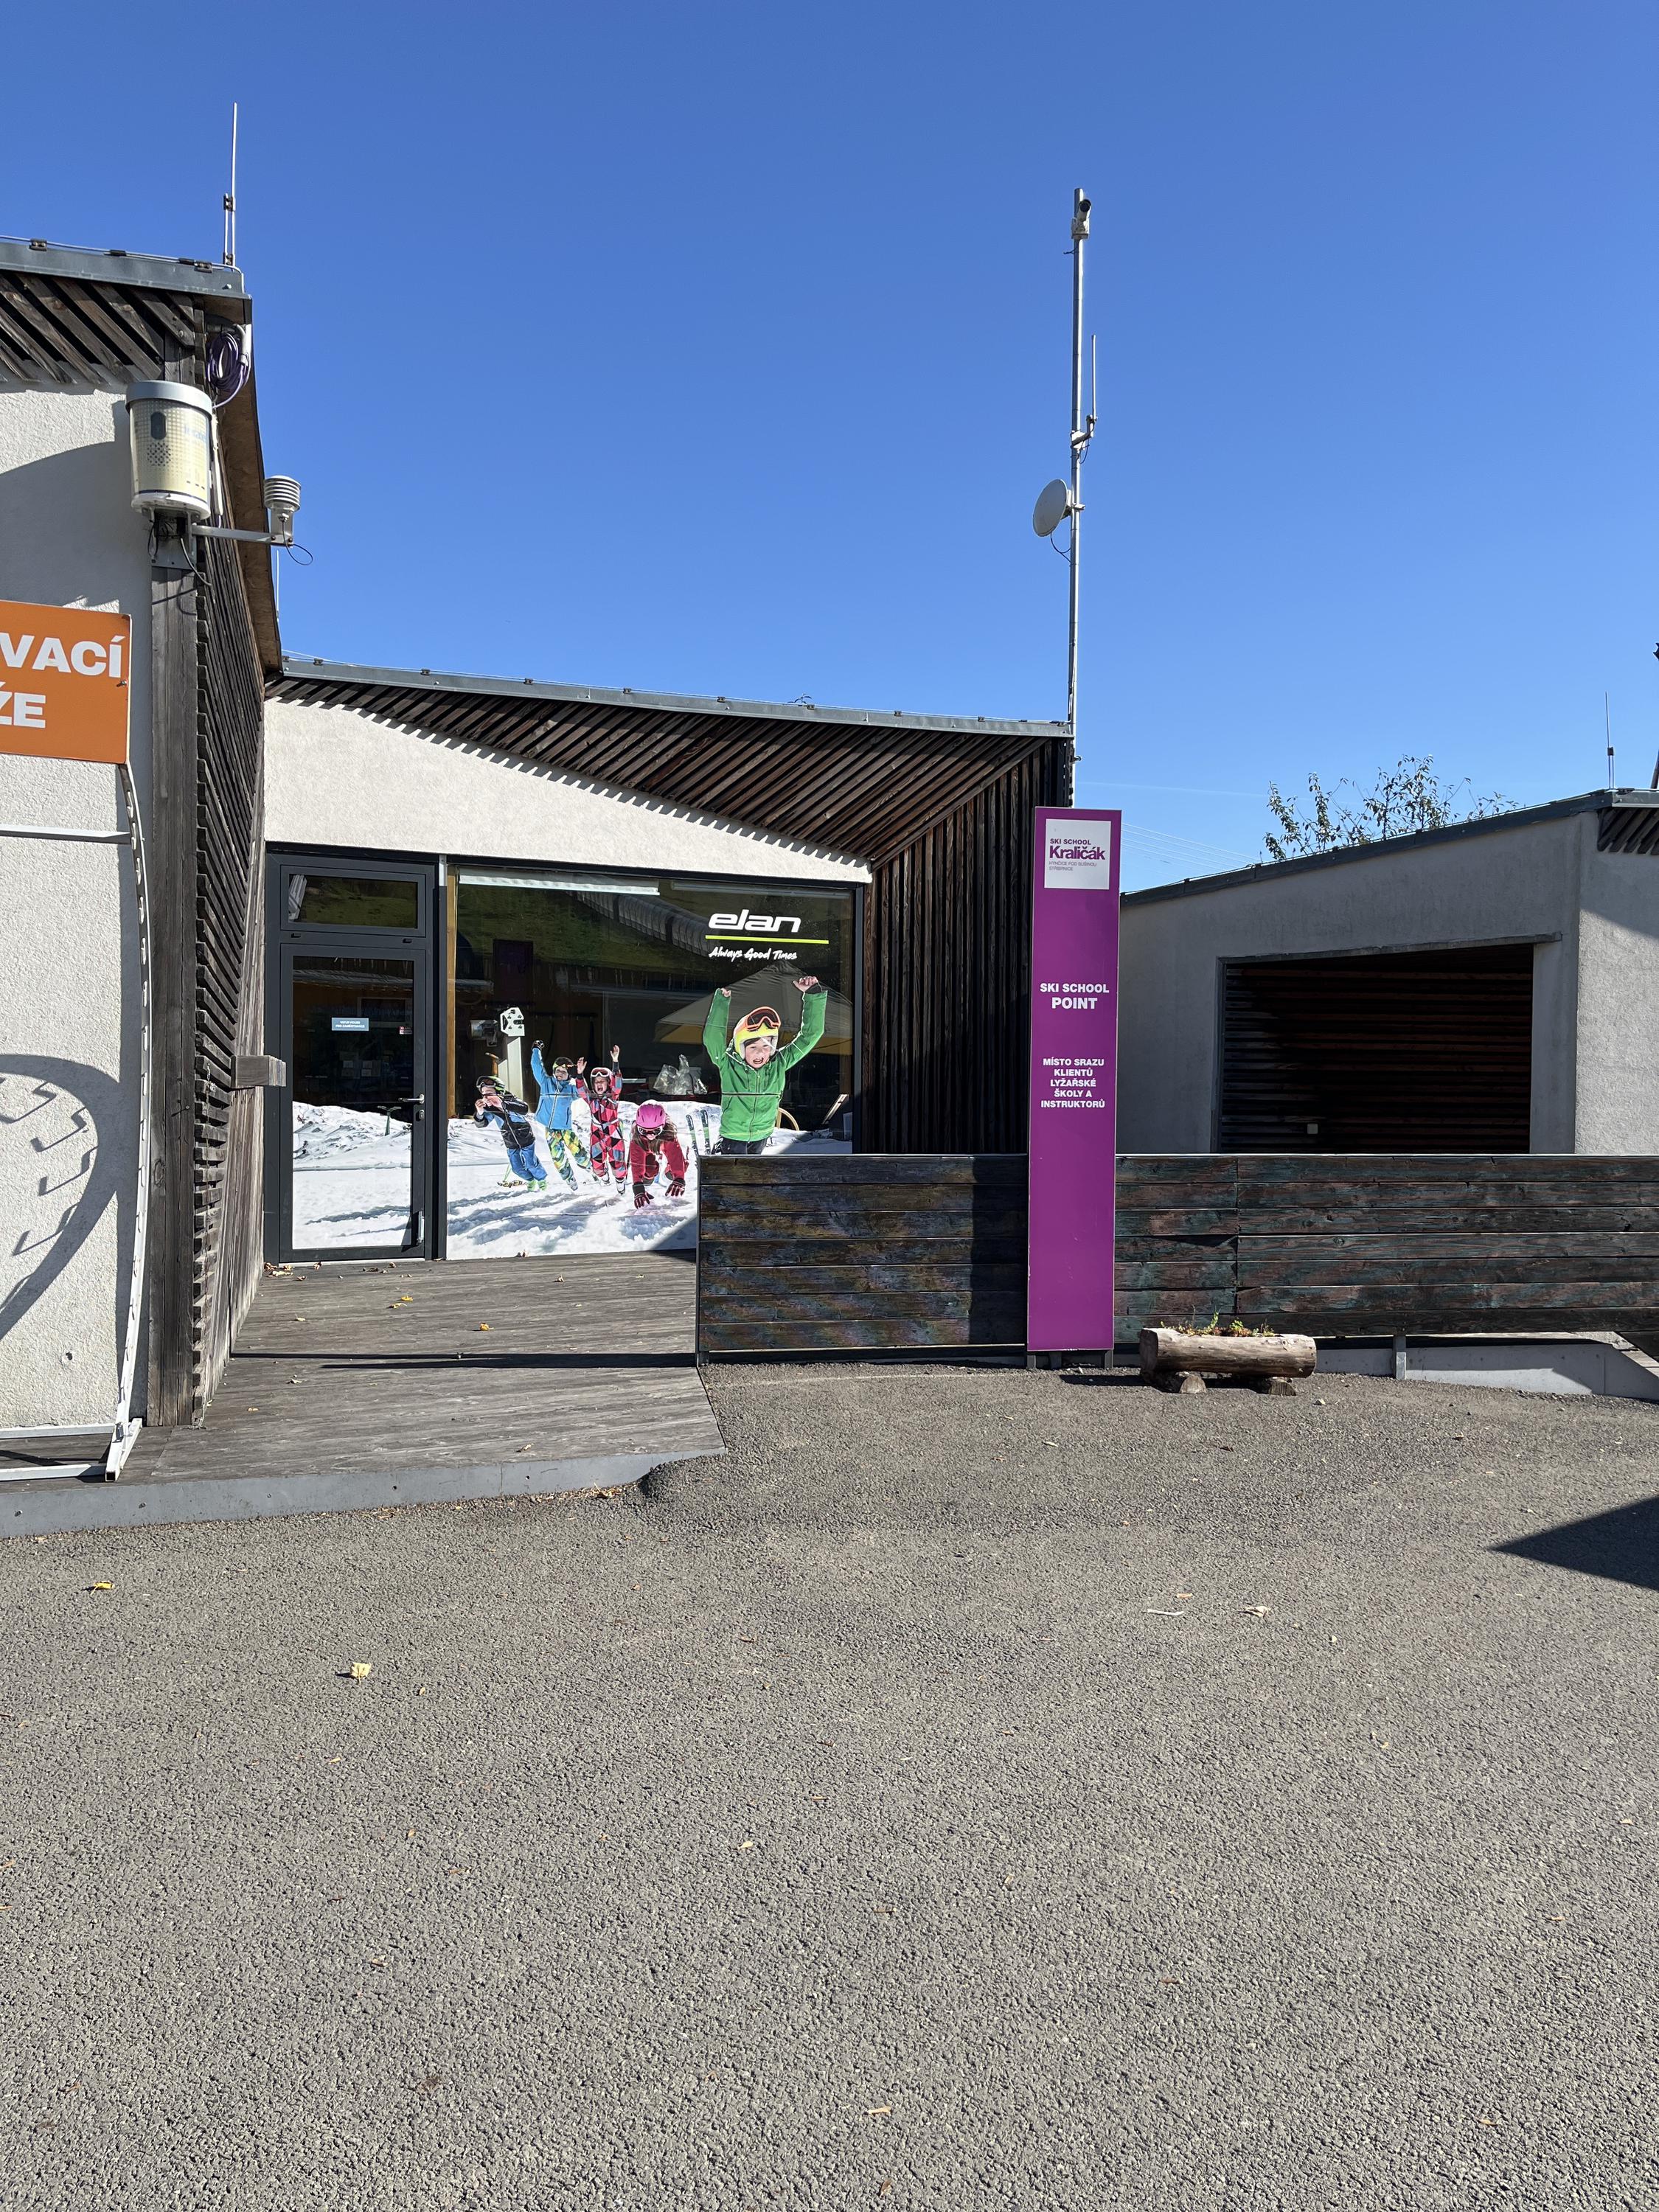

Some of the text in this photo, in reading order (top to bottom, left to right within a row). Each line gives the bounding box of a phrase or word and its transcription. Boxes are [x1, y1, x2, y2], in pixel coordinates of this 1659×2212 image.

[1049, 846, 1105, 860] Kraličák
[708, 909, 801, 933] elan
[709, 946, 798, 962] Always Good Times
[1040, 983, 1109, 993] SKI SCHOOL
[1051, 997, 1098, 1009] POINT
[1043, 1057, 1071, 1065] MÍSTO
[1054, 1067, 1093, 1077] KLIENTŮ
[1050, 1077, 1096, 1087] LYŽAŘSKÉ
[1054, 1088, 1083, 1097] ŠKOLY
[1040, 1098, 1105, 1108] INSTRUKTORŮ
